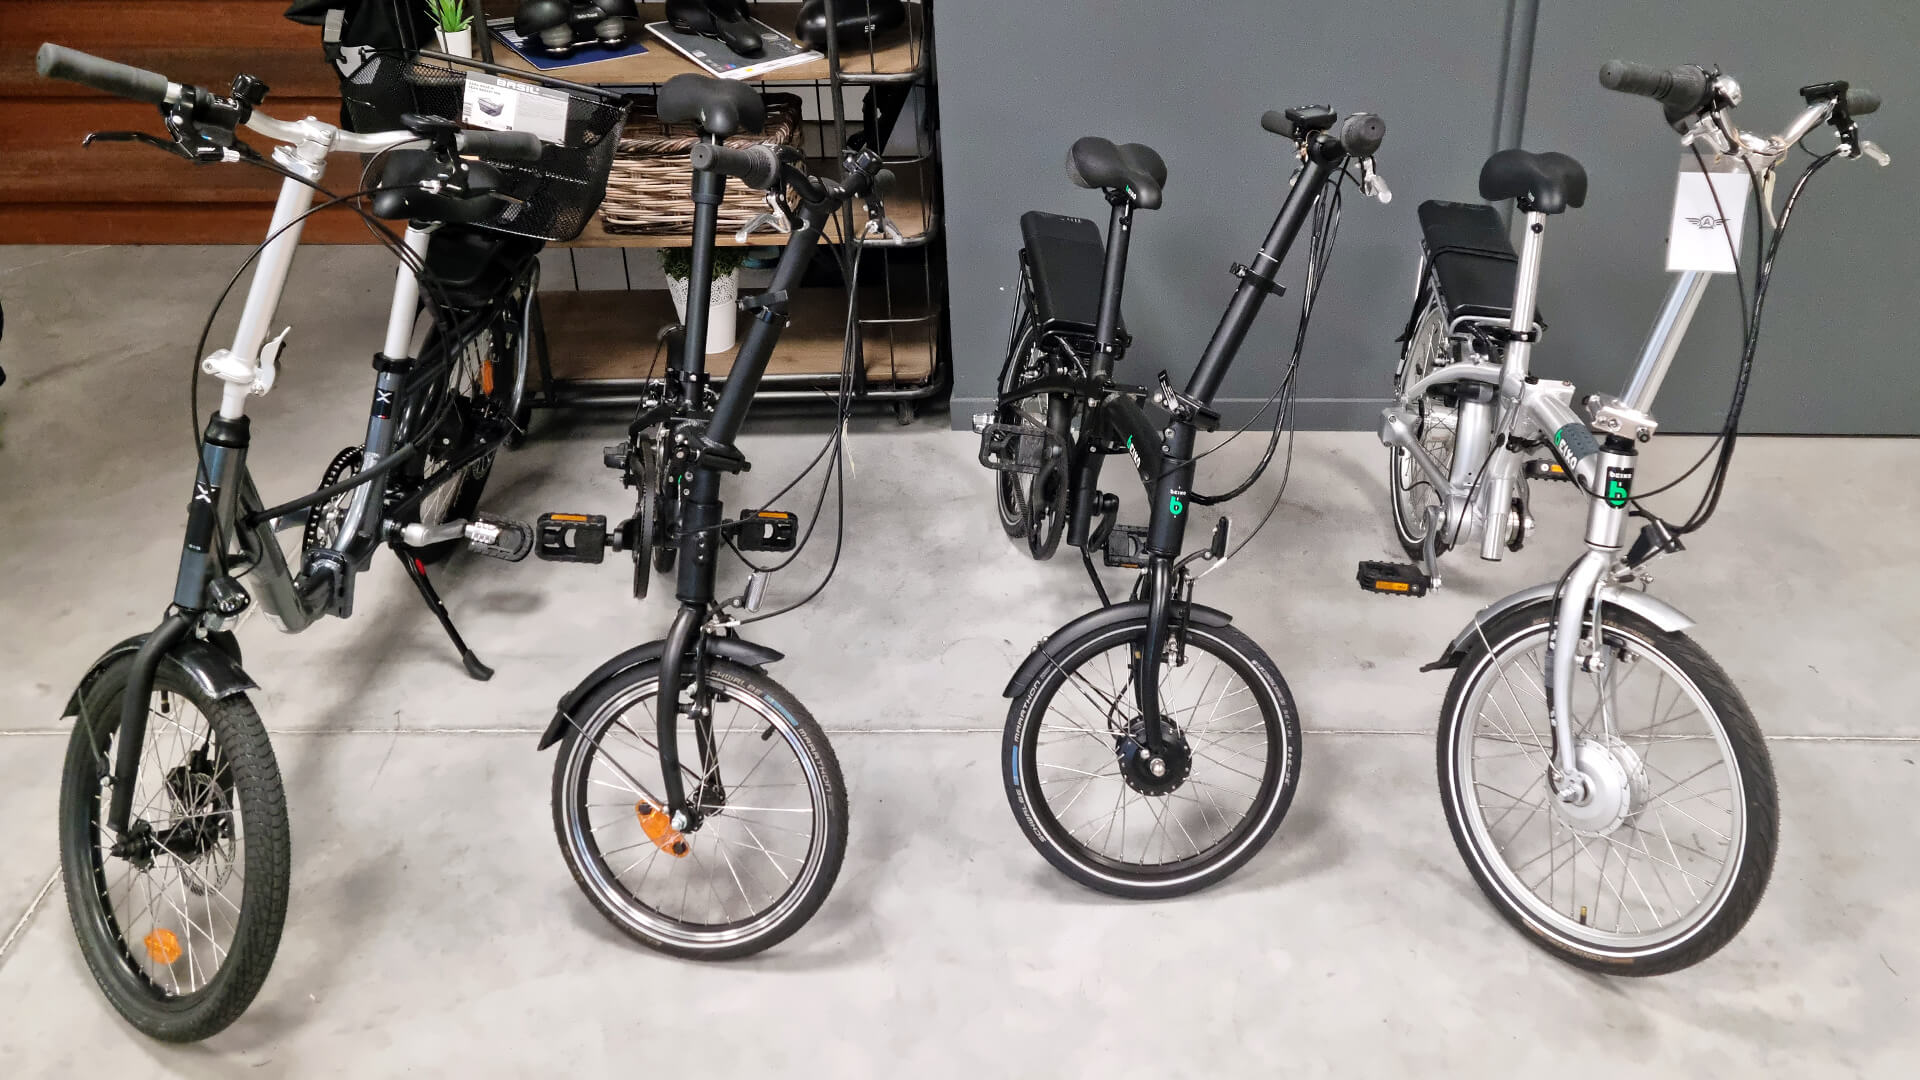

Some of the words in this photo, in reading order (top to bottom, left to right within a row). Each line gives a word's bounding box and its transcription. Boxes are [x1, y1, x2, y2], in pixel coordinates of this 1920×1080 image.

[706, 669, 764, 697] CHWALBE
[798, 727, 833, 793] MARATHON
[1014, 679, 1042, 744] MARATHON
